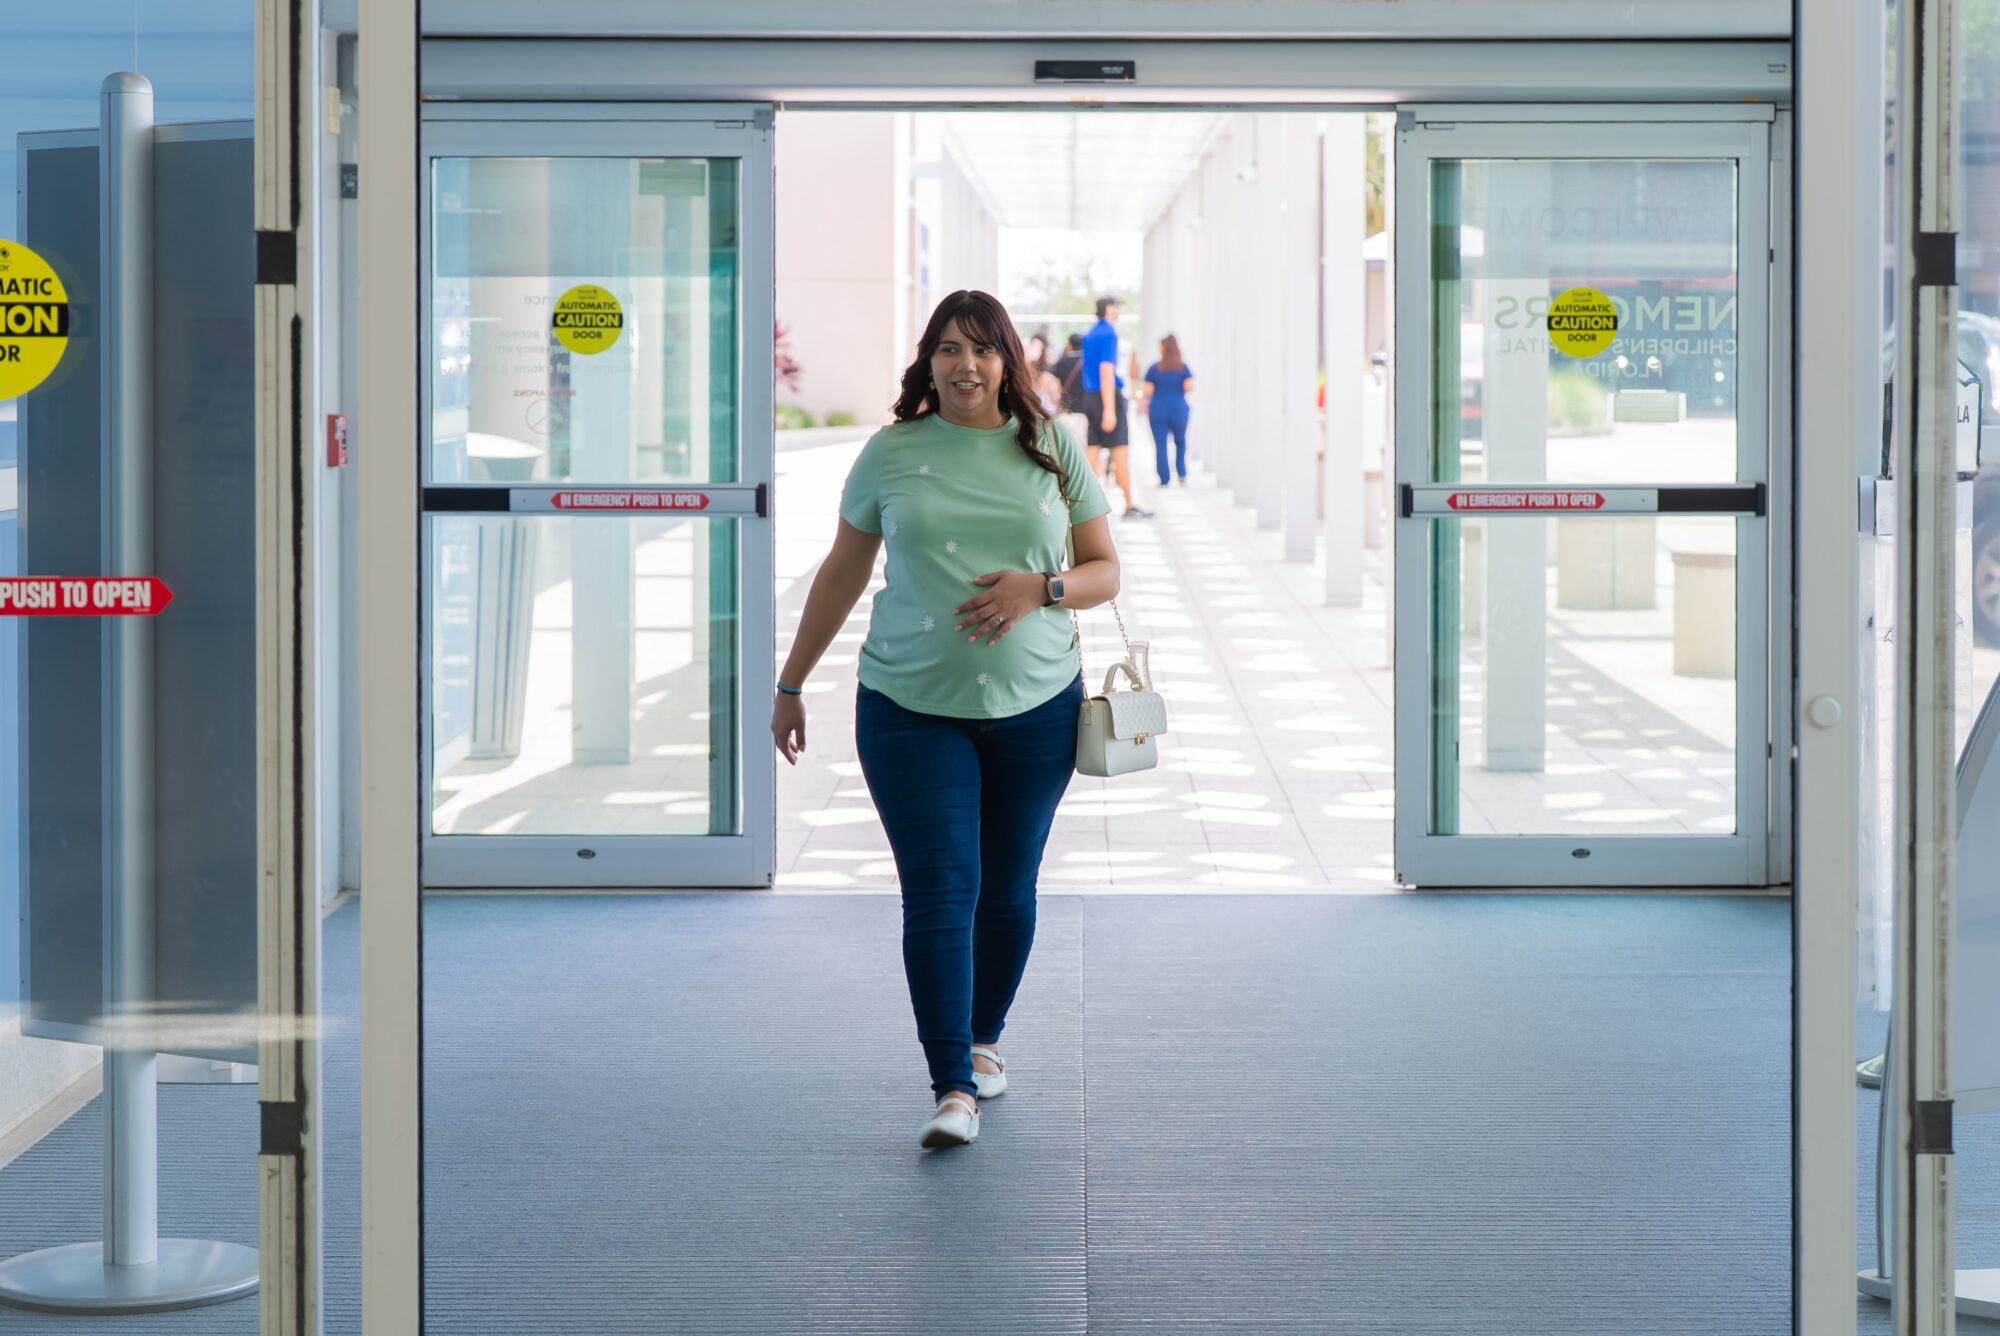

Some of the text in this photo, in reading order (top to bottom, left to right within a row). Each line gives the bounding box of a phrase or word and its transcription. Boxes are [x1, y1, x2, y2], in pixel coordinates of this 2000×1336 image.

[560, 302, 616, 310] AUTOMATIC
[1554, 304, 1611, 312] AUTOMATIC
[556, 314, 619, 327] CAUTION
[1551, 316, 1614, 329] CAUTION
[573, 331, 602, 339] DOOR
[1568, 334, 1597, 342] DOOR
[560, 493, 701, 507] IN EMERGENCY PUSH TO OPEN
[1456, 494, 1596, 507] IN EMERGENCY PUSH TO OPEN
[0, 580, 151, 608] PUSH TO OPEN
